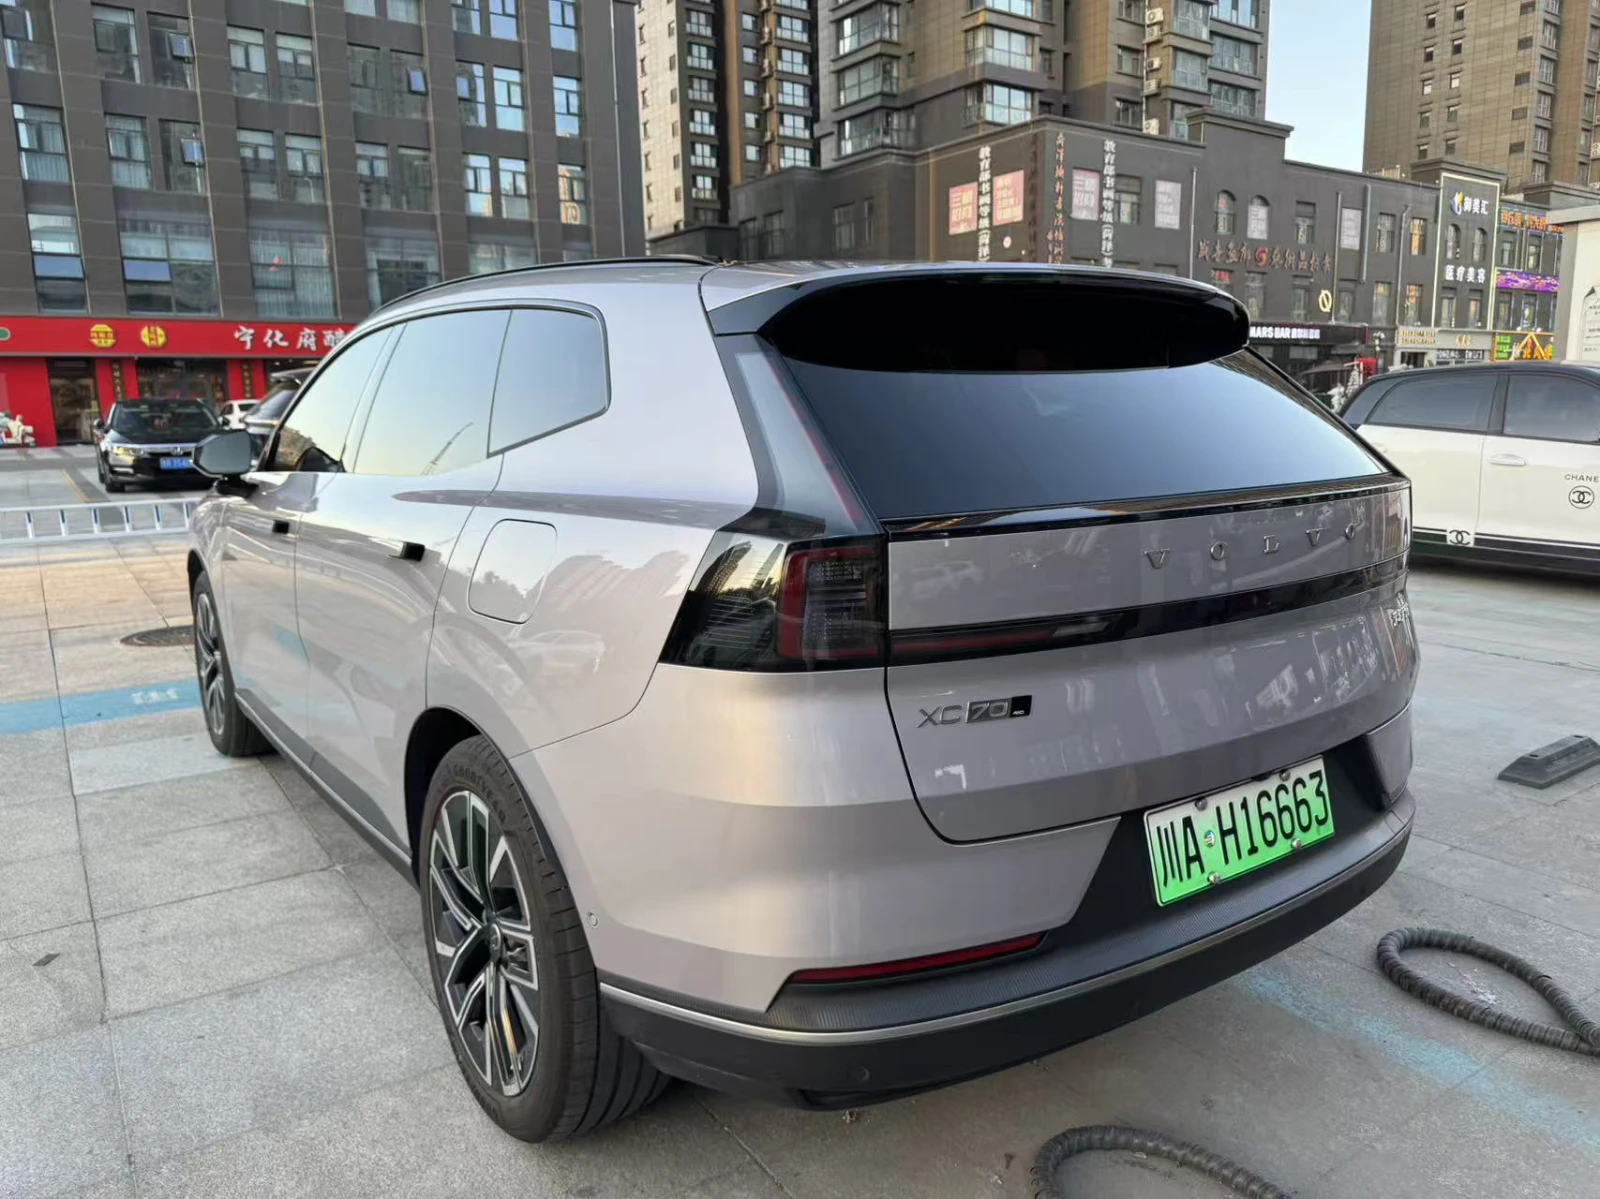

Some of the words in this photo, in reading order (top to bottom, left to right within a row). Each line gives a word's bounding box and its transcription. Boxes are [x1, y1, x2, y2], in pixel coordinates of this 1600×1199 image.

[1445, 264, 1486, 284] 医疗美容
[1274, 327, 1291, 339] BAR
[1144, 523, 1355, 570] VOLVO
